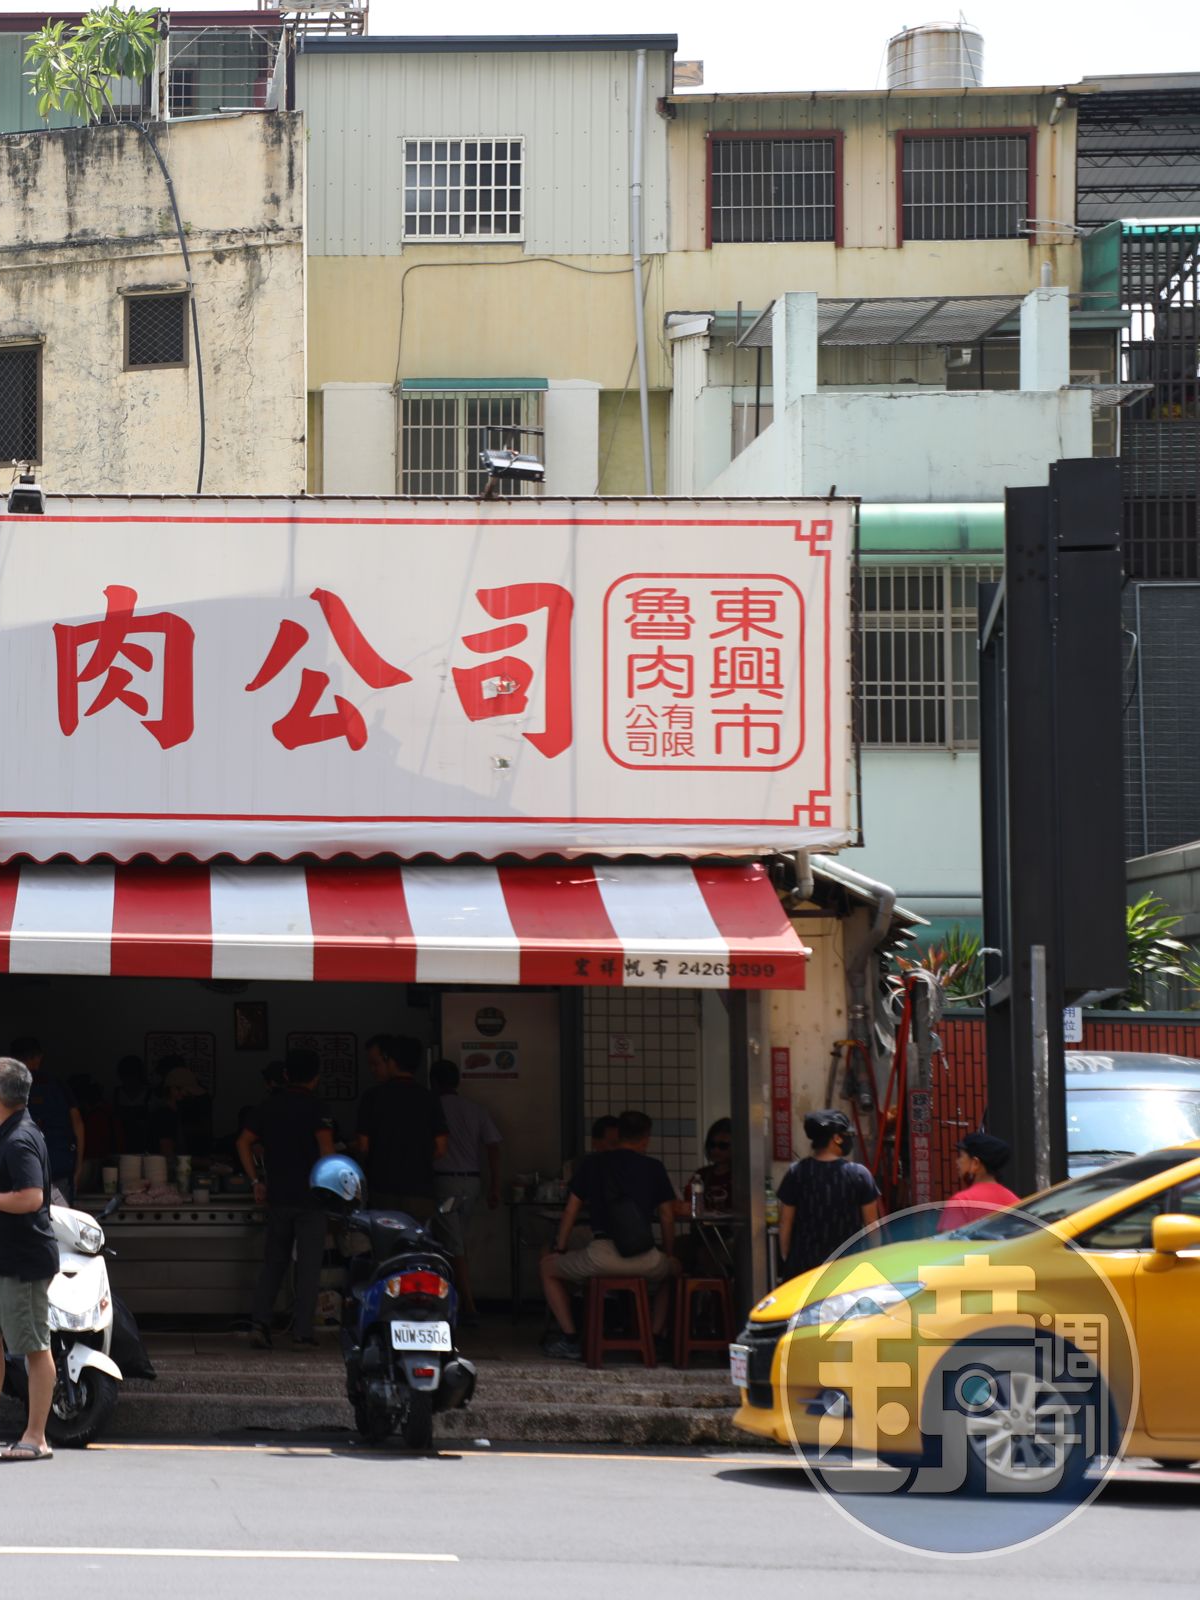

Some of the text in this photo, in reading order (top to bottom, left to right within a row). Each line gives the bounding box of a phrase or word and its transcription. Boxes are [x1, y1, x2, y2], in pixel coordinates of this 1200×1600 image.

[624, 587, 696, 699] 魯肉
[709, 587, 785, 758] 東興市
[625, 704, 658, 757] 公司
[661, 704, 696, 757] 有限
[678, 961, 776, 977] 24263399
